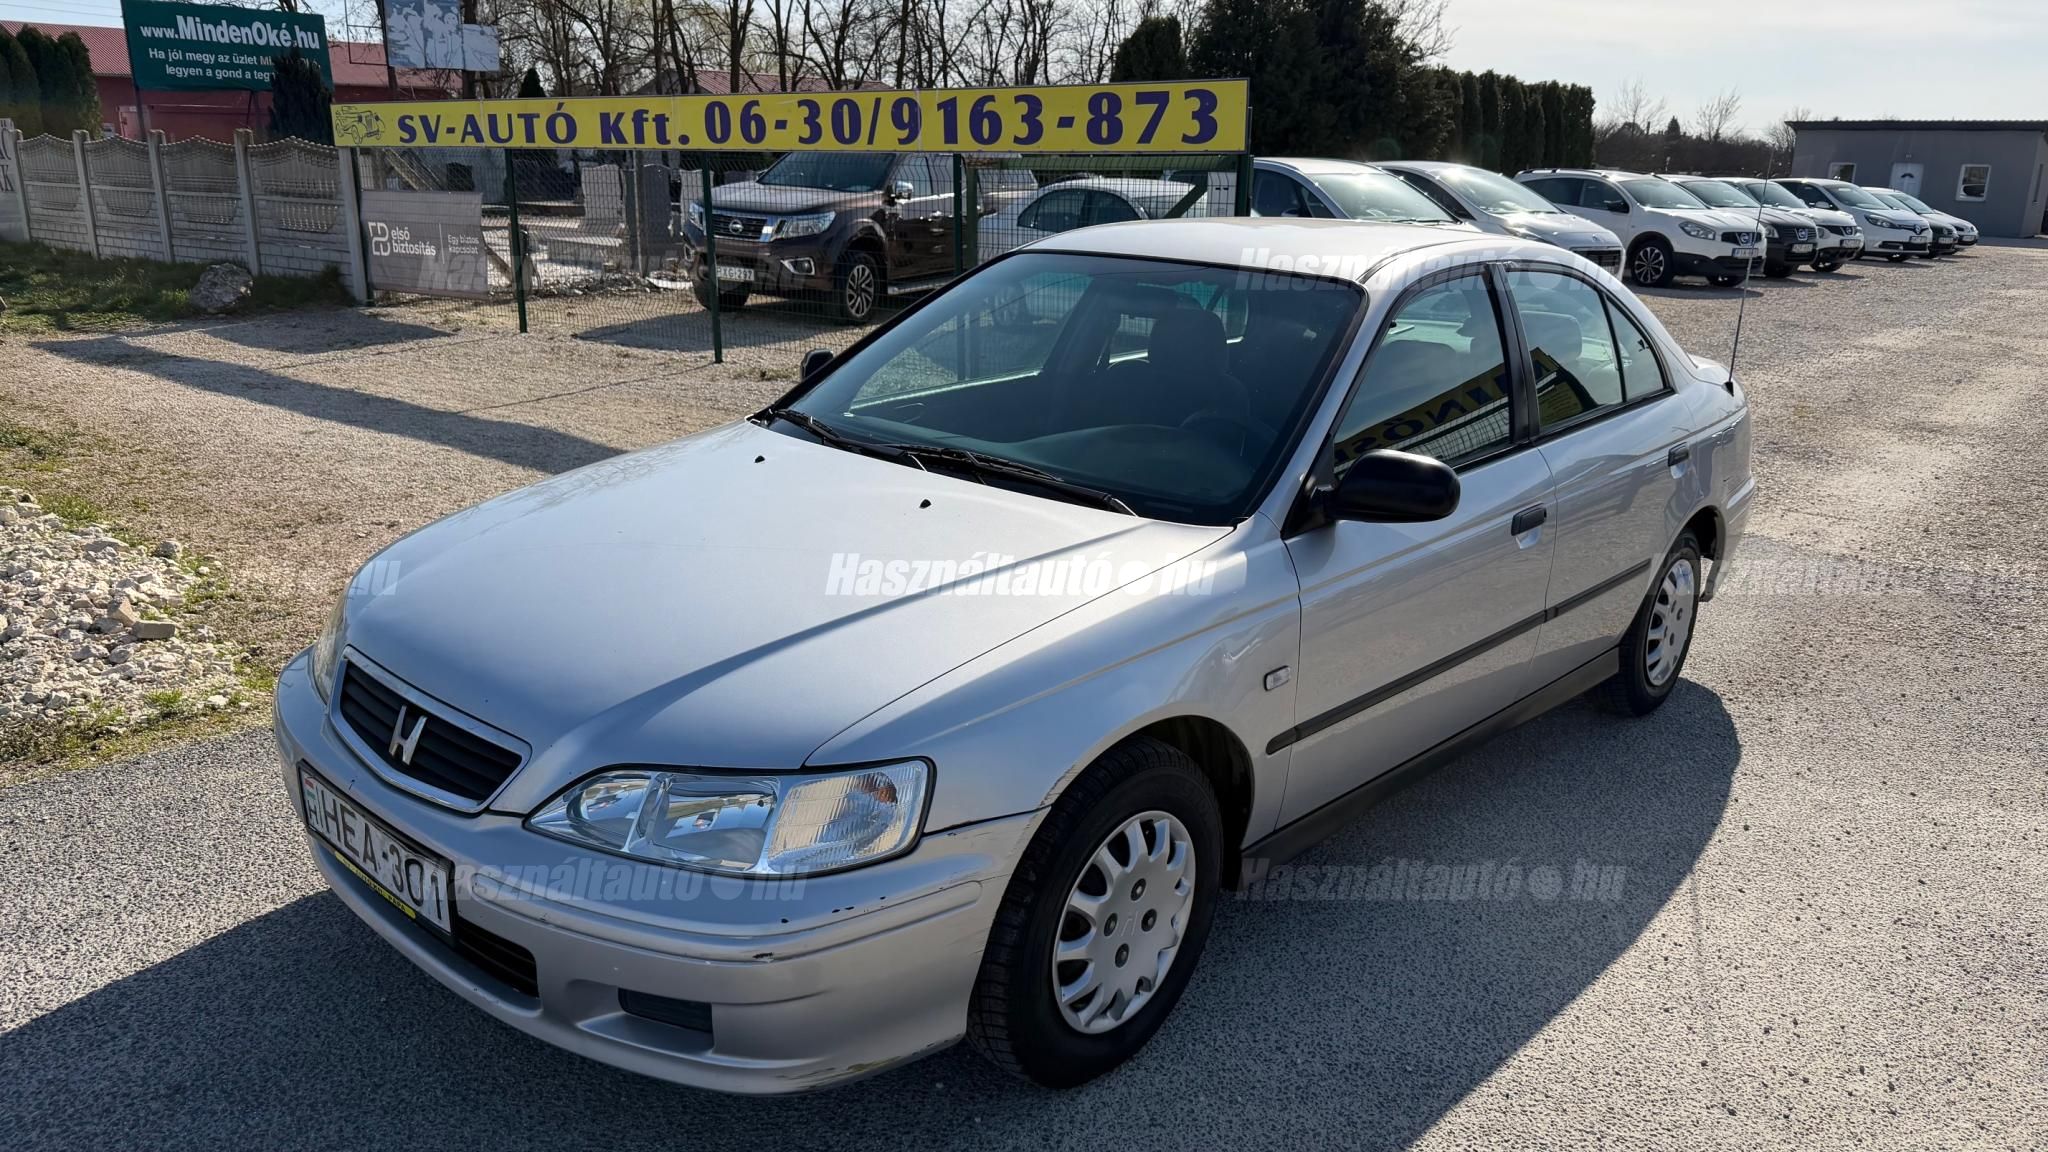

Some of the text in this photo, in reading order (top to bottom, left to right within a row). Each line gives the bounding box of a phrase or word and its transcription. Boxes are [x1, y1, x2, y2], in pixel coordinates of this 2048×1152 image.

[140, 15, 320, 49] www.MindenOké.hu
[148, 48, 165, 60] Ha
[168, 49, 183, 62] jól
[185, 53, 215, 64] megy
[218, 54, 230, 63] az
[232, 52, 257, 65] üzlet
[166, 64, 203, 78] legyen
[206, 68, 213, 76] a
[216, 66, 242, 80] gond
[245, 71, 251, 79] a
[398, 102, 577, 144] SV-AUTÓ
[600, 108, 690, 146] Kft.
[391, 227, 410, 240] első
[392, 241, 437, 256] biztosítás
[321, 789, 442, 921] HEA-301
